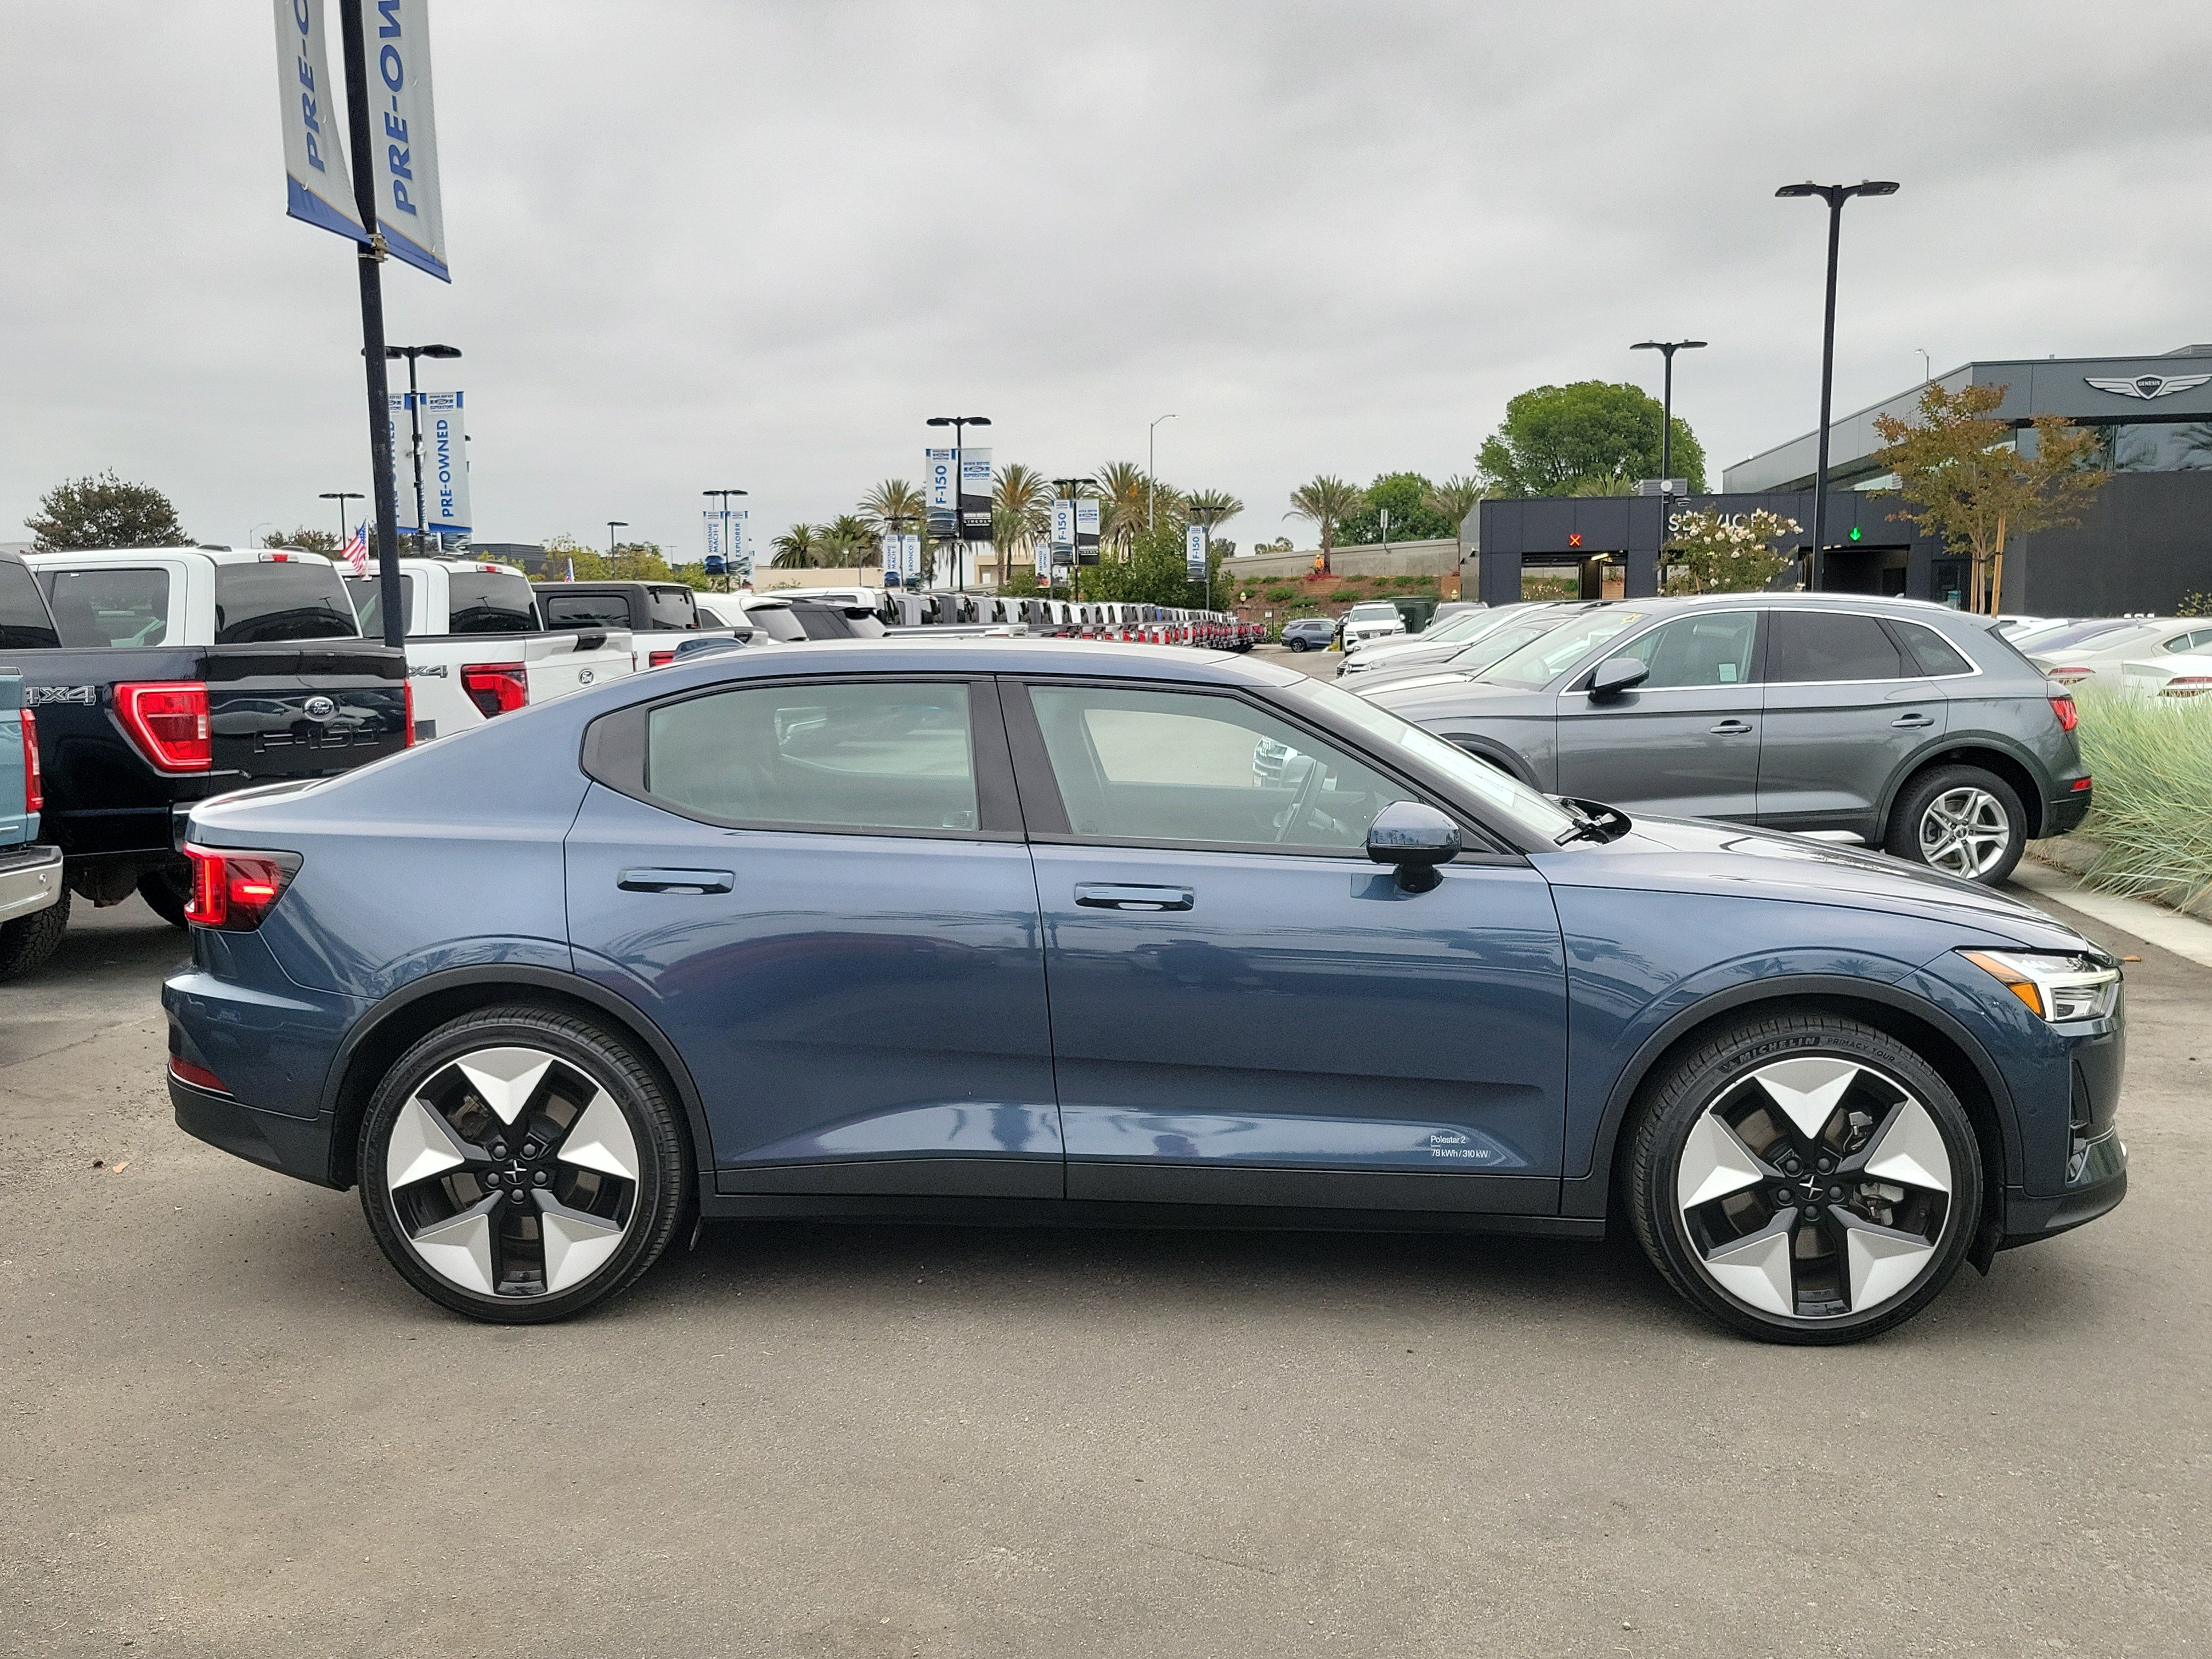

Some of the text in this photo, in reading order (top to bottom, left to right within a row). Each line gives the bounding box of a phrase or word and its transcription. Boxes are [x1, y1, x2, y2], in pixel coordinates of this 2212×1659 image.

[437, 419, 454, 517] PRE-OWNED
[935, 465, 947, 504] F-150
[1058, 512, 1066, 540] F-150
[1668, 512, 1759, 532] SEVICE
[1740, 1036, 1895, 1063] MICHELIN PRIMACY TOUR
[1431, 1135, 1459, 1144] Polestar
[1476, 1150, 1488, 1158] kW
